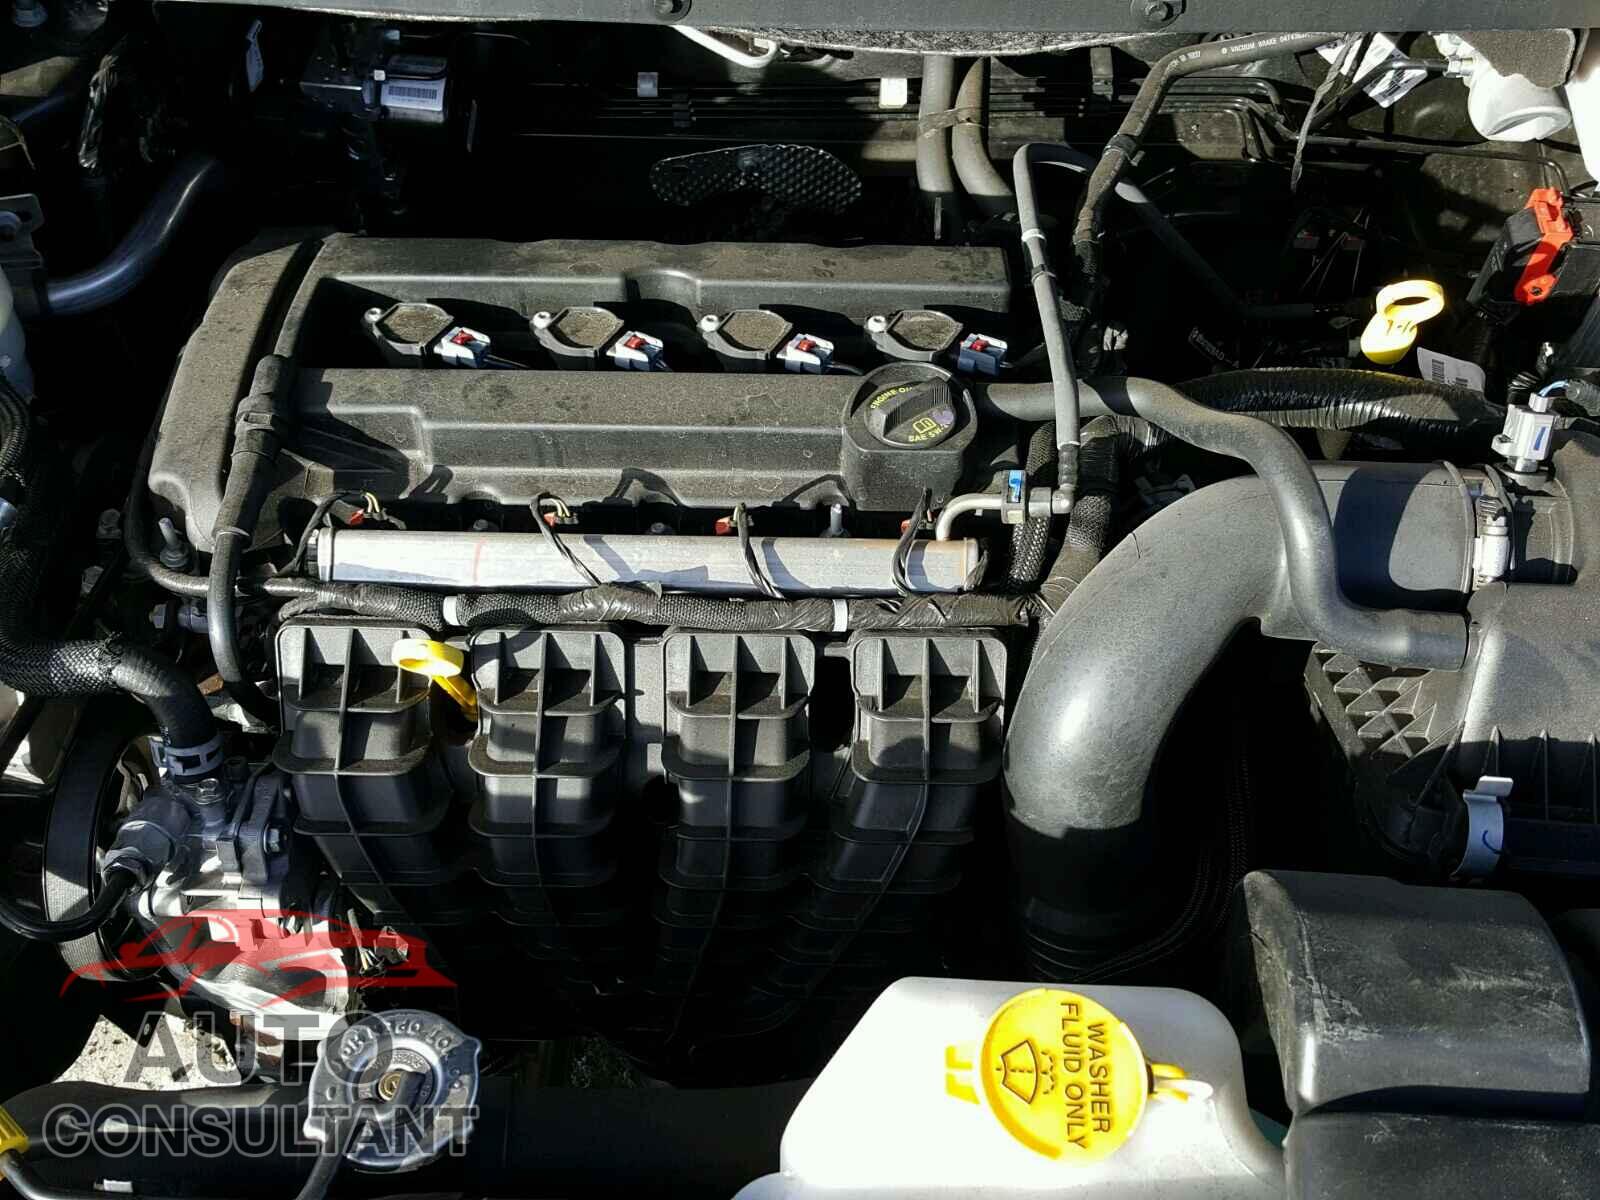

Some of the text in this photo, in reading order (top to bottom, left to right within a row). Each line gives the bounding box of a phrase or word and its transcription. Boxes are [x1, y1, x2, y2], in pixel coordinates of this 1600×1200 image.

[1230, 42, 1255, 53] VACUUM
[1257, 38, 1277, 48] BRAKE
[870, 388, 897, 409] ENGINE
[908, 433, 928, 442] SAE
[1060, 1002, 1088, 1150] FLUID ONLY
[1087, 1021, 1112, 1134] WASHER
